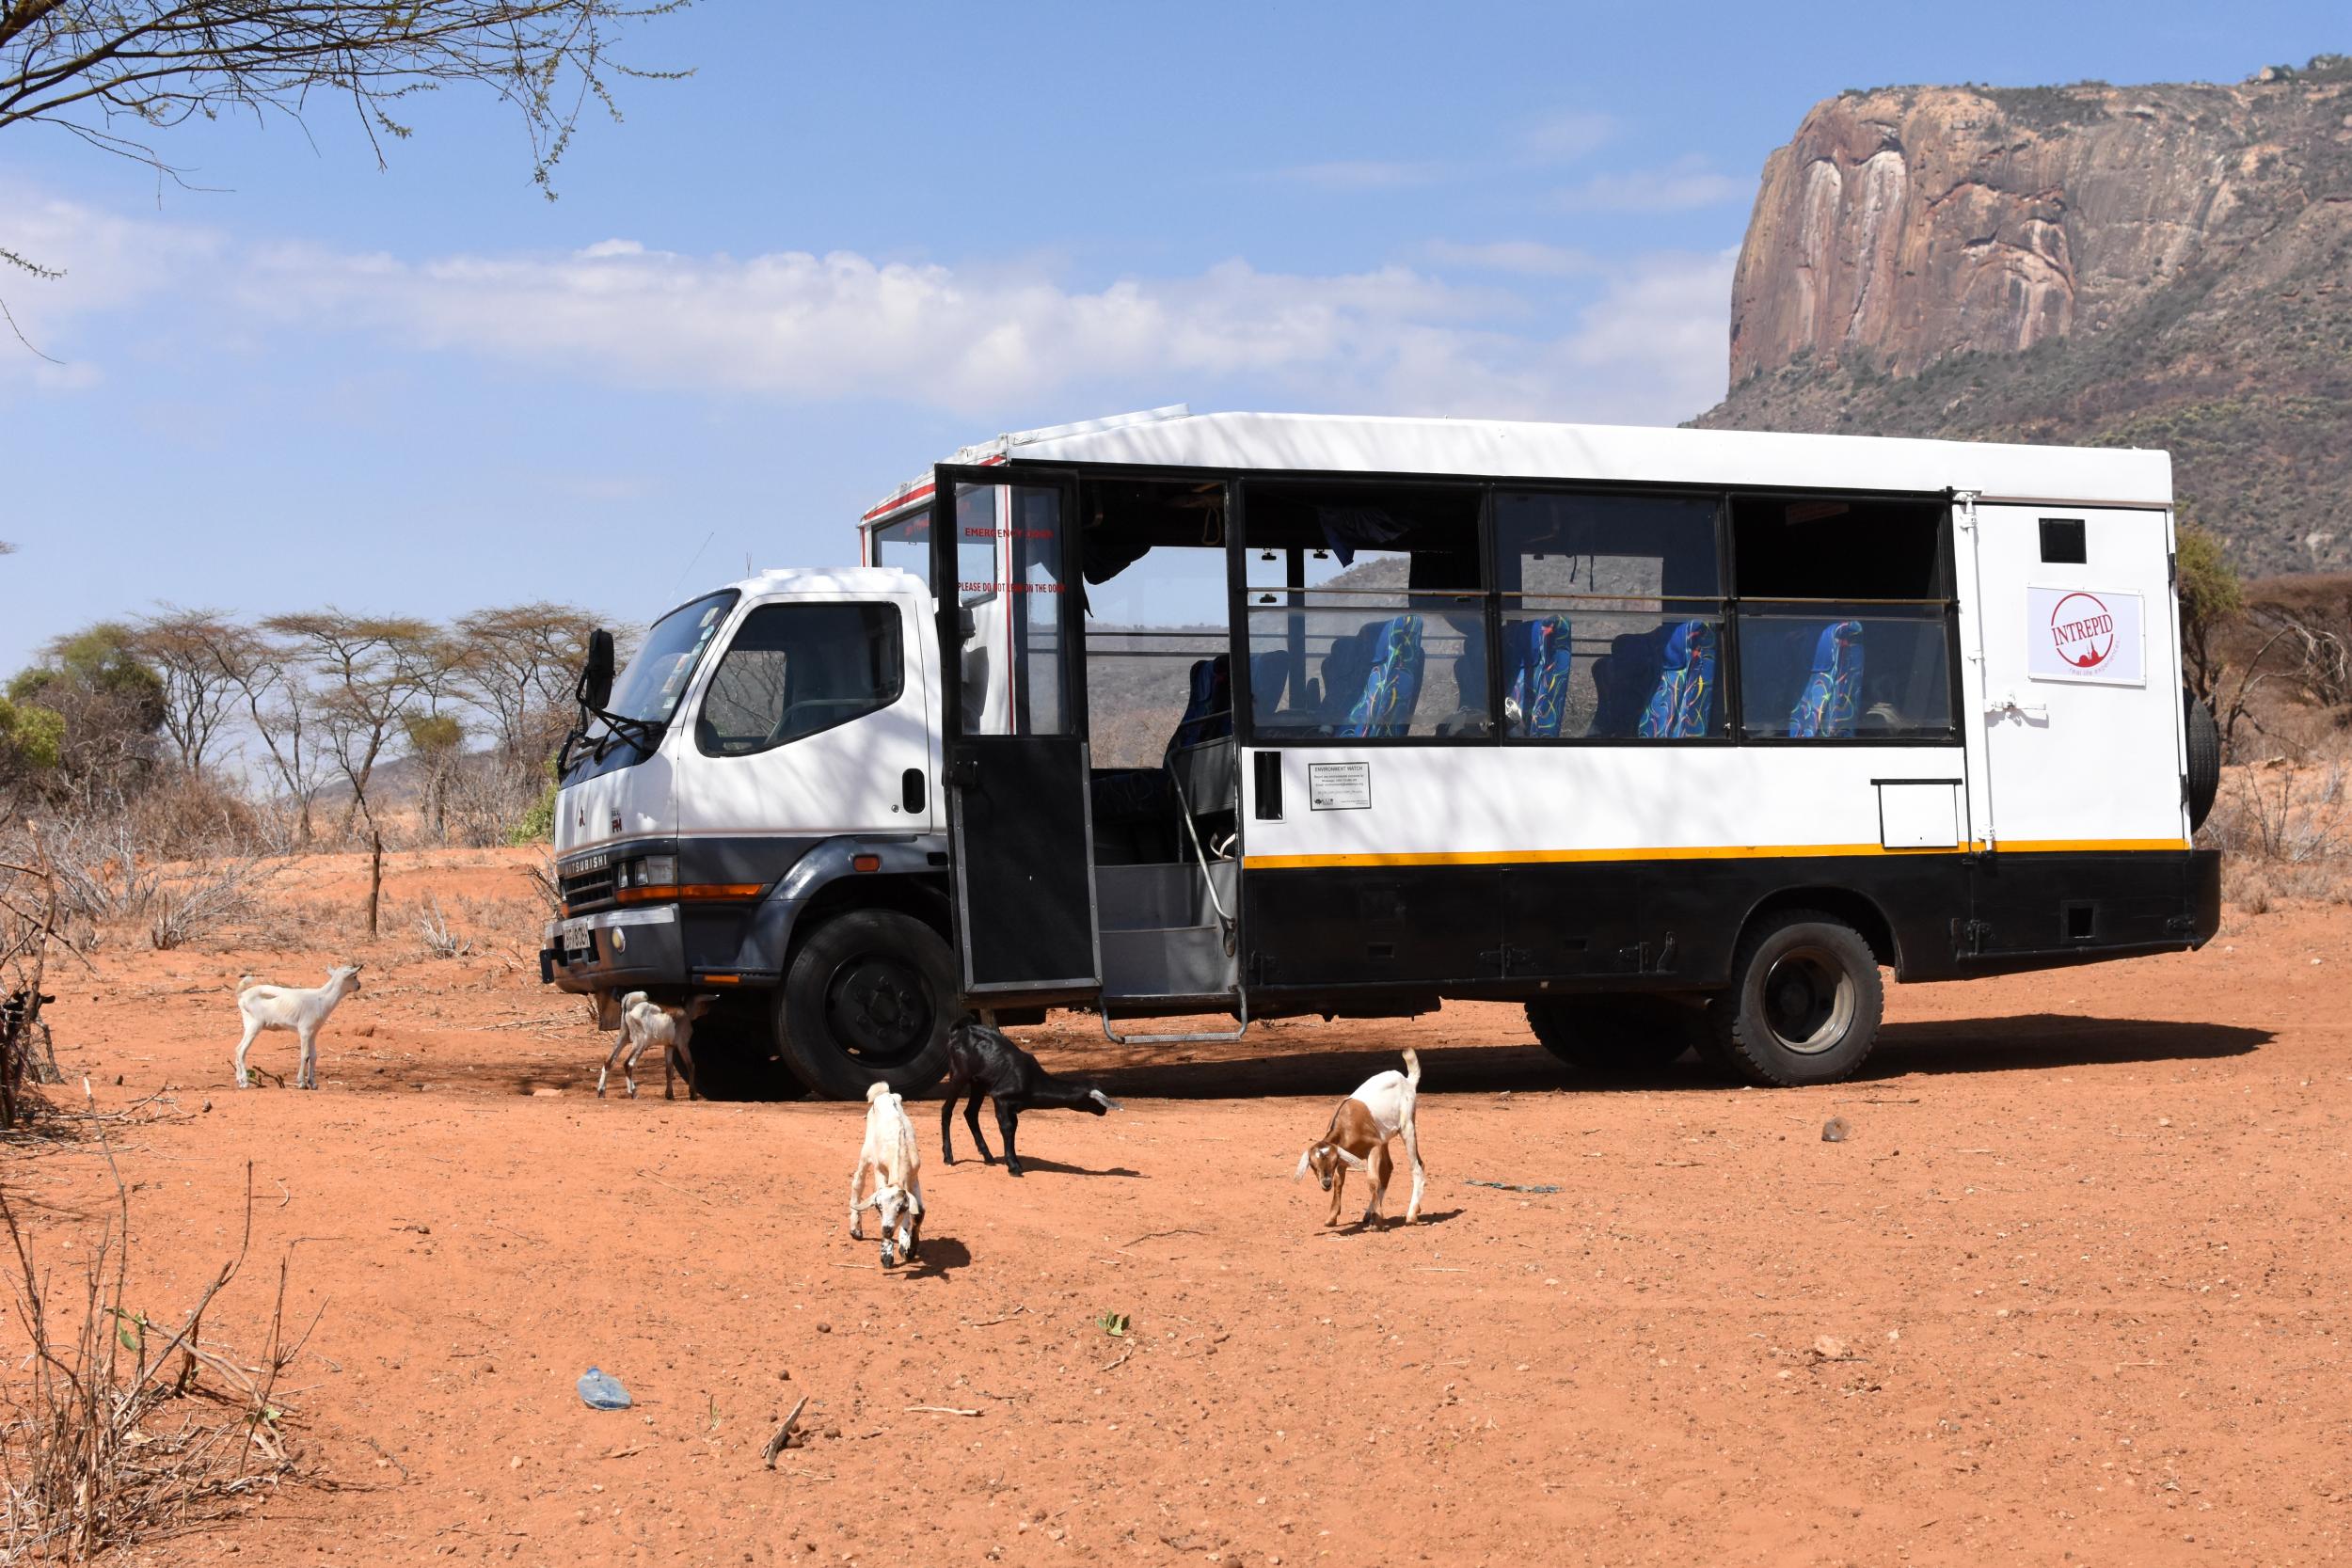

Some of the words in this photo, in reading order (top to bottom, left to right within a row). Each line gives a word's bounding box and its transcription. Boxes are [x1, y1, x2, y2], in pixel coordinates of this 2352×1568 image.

[964, 527, 1023, 538] EMERGENCY
[958, 582, 981, 592] PLEASE
[982, 582, 992, 593] DO
[1025, 583, 1033, 593] ON
[1035, 584, 1047, 593] THE
[2051, 613, 2114, 647] INTREPID
